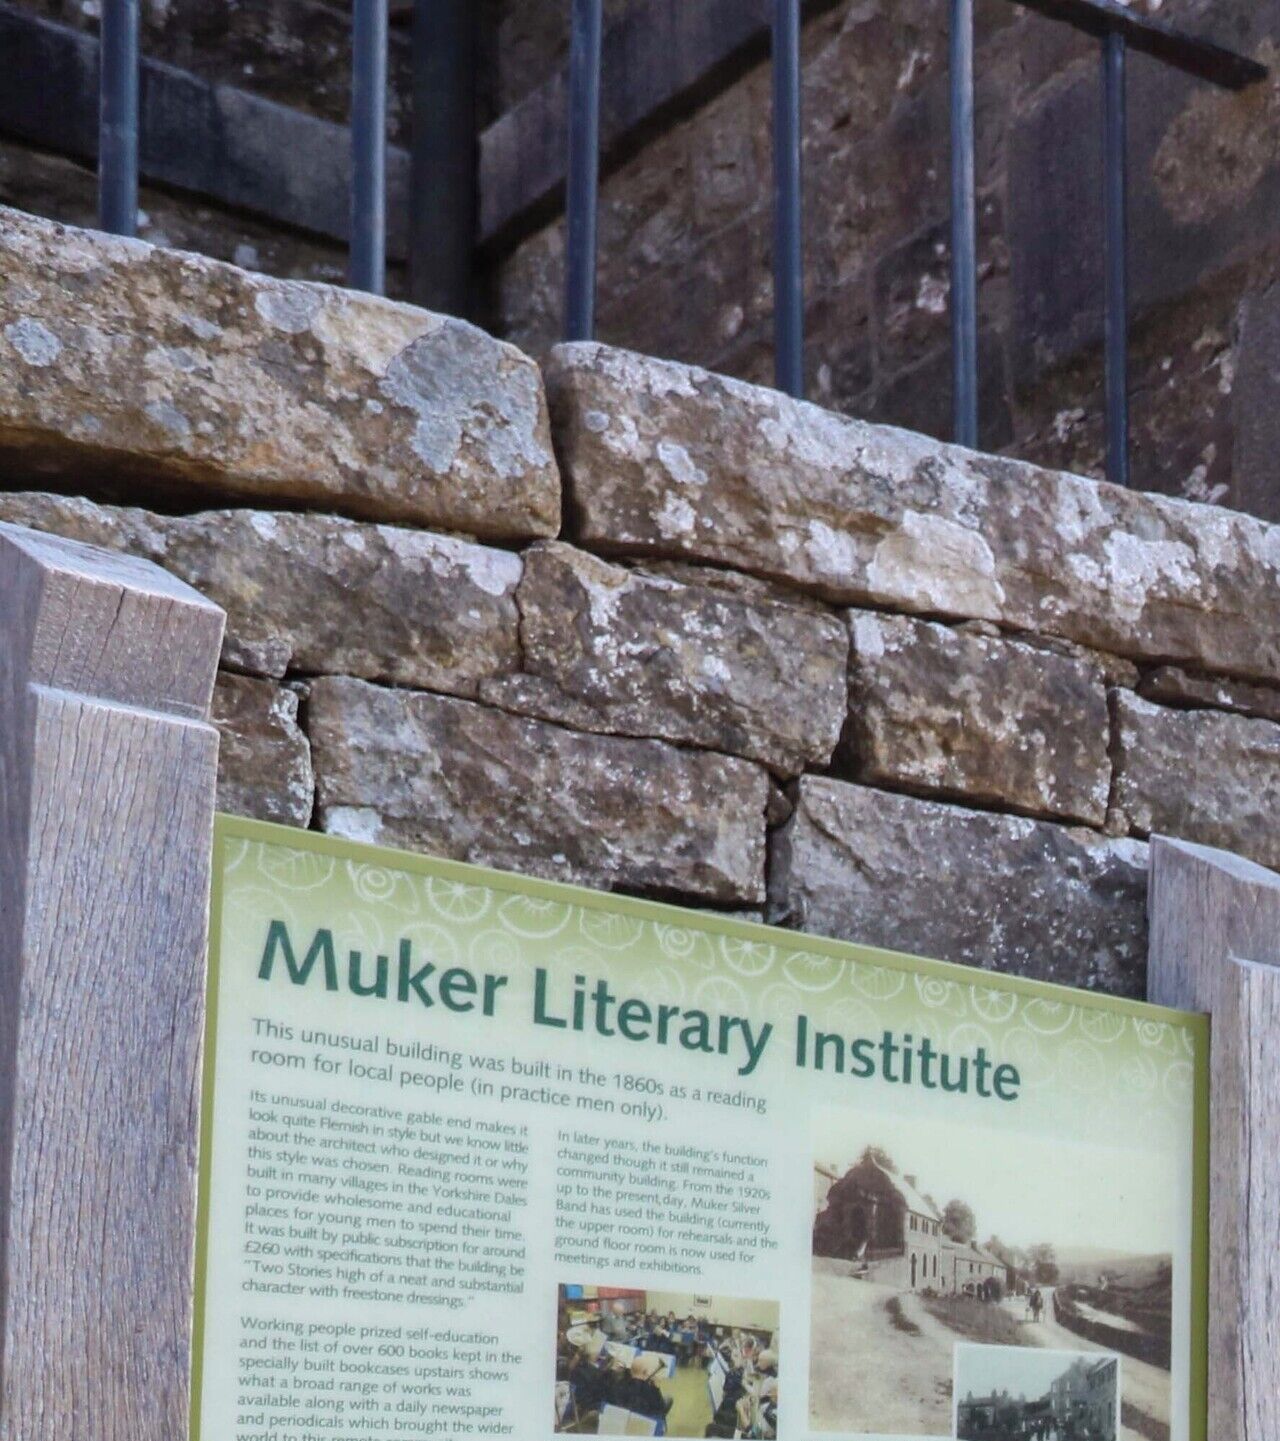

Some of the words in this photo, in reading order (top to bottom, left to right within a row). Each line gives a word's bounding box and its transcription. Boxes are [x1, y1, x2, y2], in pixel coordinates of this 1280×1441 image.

[258, 919, 508, 1017] Muker
[533, 967, 773, 1076] Literary
[796, 1014, 1020, 1101] Institute
[252, 1018, 294, 1040] This
[301, 1030, 379, 1053] unusual
[386, 1037, 463, 1070] building
[469, 1055, 505, 1072] was
[511, 1056, 551, 1078] built
[557, 1064, 572, 1082] in
[578, 1067, 607, 1087] the
[613, 1074, 664, 1096] 1860s
[669, 1086, 687, 1099] as
[692, 1089, 701, 1101] a
[707, 1090, 767, 1114] reading
[251, 1050, 305, 1069] room
[313, 1053, 342, 1074] for
[349, 1059, 393, 1081] local
[400, 1071, 464, 1094] people
[471, 1077, 494, 1096] (in
[501, 1085, 571, 1106] practice
[576, 1096, 615, 1112] men
[620, 1101, 667, 1123] only).
[249, 1107, 278, 1123] look
[282, 1115, 316, 1129] quite
[320, 1117, 369, 1134] Flemish
[373, 1124, 384, 1136] in
[388, 1127, 417, 1142] style
[419, 1129, 441, 1143] but
[444, 1136, 464, 1146] we
[466, 1135, 501, 1151] know
[504, 1140, 529, 1154] little
[250, 1090, 267, 1103] Its
[271, 1095, 327, 1111] unusual
[331, 1099, 402, 1121] decorative
[407, 1111, 443, 1126] gable
[446, 1117, 472, 1129] end
[475, 1121, 516, 1136] makes
[520, 1126, 528, 1137] it
[248, 1127, 290, 1144] about
[293, 1131, 316, 1147] the
[319, 1137, 377, 1154] architect
[380, 1142, 410, 1158] who
[413, 1146, 470, 1165] designed
[473, 1155, 482, 1166] it
[485, 1158, 499, 1168] or
[502, 1156, 528, 1174] why
[248, 1145, 272, 1160] this
[276, 1150, 308, 1166] style
[311, 1156, 339, 1168] was
[398, 1162, 451, 1184] Reading
[454, 1172, 494, 1185] rooms
[497, 1178, 528, 1189] were
[246, 1184, 261, 1197] to
[265, 1188, 320, 1203] provide
[324, 1192, 403, 1211] wholesome
[407, 1202, 433, 1215] and
[436, 1204, 511, 1222] educational
[247, 1164, 277, 1180] built
[281, 1168, 294, 1181] in
[298, 1173, 337, 1189] many
[340, 1175, 388, 1193] villages
[392, 1181, 404, 1193] in
[408, 1182, 429, 1196] the
[432, 1184, 491, 1203] Yorkshire
[494, 1191, 528, 1207] Dales
[555, 1215, 576, 1229] the
[579, 1221, 615, 1234] upper
[618, 1225, 655, 1238] room)
[657, 1225, 675, 1239] for
[677, 1229, 735, 1245] rehearsals
[736, 1236, 757, 1247] and
[760, 1236, 778, 1249] the
[556, 1198, 587, 1213] Band
[590, 1200, 611, 1216] has
[614, 1207, 643, 1219] used
[646, 1208, 665, 1221] the
[668, 1210, 714, 1229] building
[717, 1216, 770, 1235] (currently
[554, 1234, 600, 1249] ground
[603, 1236, 632, 1251] floor
[634, 1243, 666, 1254] room
[669, 1244, 678, 1256] is
[680, 1248, 706, 1259] now
[709, 1250, 736, 1262] used
[739, 1251, 755, 1263] for
[554, 1253, 610, 1269] meetings
[613, 1257, 636, 1269] and
[240, 1316, 304, 1336] Working
[308, 1322, 356, 1339] people
[360, 1326, 402, 1340] prized
[406, 1327, 499, 1345] self-education
[239, 1336, 267, 1349] and
[272, 1337, 295, 1351] the
[300, 1338, 319, 1352] list
[323, 1340, 339, 1354] of
[342, 1344, 373, 1355] over
[377, 1344, 405, 1358] 600
[409, 1345, 448, 1360] books
[453, 1348, 481, 1364] kept
[485, 1352, 498, 1363] in
[502, 1351, 522, 1364] the
[239, 1356, 299, 1373] specially
[304, 1357, 335, 1374] built
[339, 1359, 410, 1376] bookcases
[414, 1366, 464, 1380] upstairs
[469, 1366, 509, 1381] shows
[238, 1373, 276, 1388] what
[280, 1379, 288, 1388] a
[293, 1376, 335, 1391] broad
[339, 1382, 379, 1396] range
[383, 1381, 397, 1393] of
[401, 1383, 441, 1396] works
[445, 1387, 471, 1397] was
[236, 1412, 264, 1425] and
[269, 1414, 344, 1430] periodicals
[348, 1415, 389, 1430] which
[394, 1417, 448, 1435] brought
[452, 1420, 473, 1433] the
[478, 1422, 513, 1434] wider
[237, 1393, 301, 1408] available
[305, 1395, 345, 1414] along
[349, 1398, 379, 1411] with
[383, 1402, 392, 1411] a
[396, 1399, 428, 1417] daily
[432, 1404, 503, 1418] newspaper
